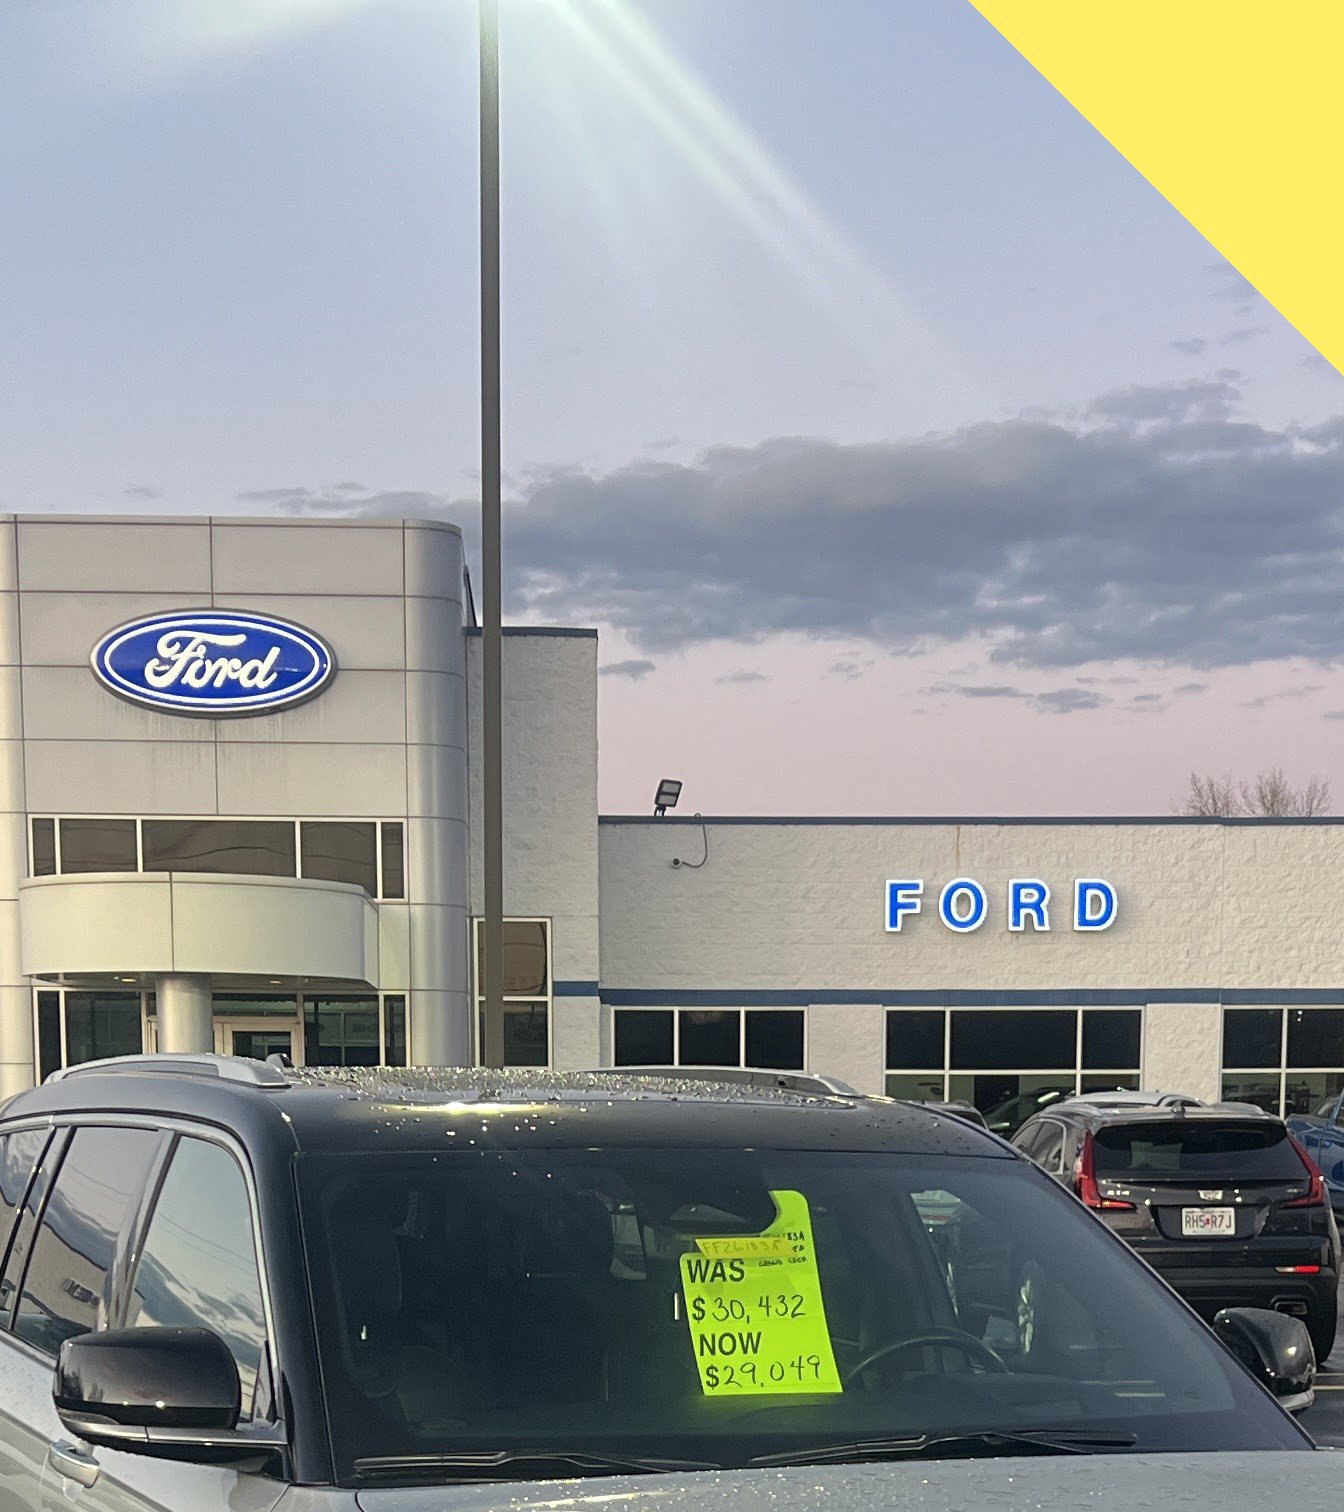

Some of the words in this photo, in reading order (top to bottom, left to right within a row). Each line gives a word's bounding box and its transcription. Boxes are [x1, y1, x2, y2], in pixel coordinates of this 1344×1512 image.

[144, 629, 281, 689] Ford
[885, 877, 1118, 932] FORD
[1184, 1214, 1206, 1229] RH5
[1210, 1214, 1232, 1229] R7J
[686, 1257, 745, 1284] WAS
[699, 1331, 762, 1357] NOW
